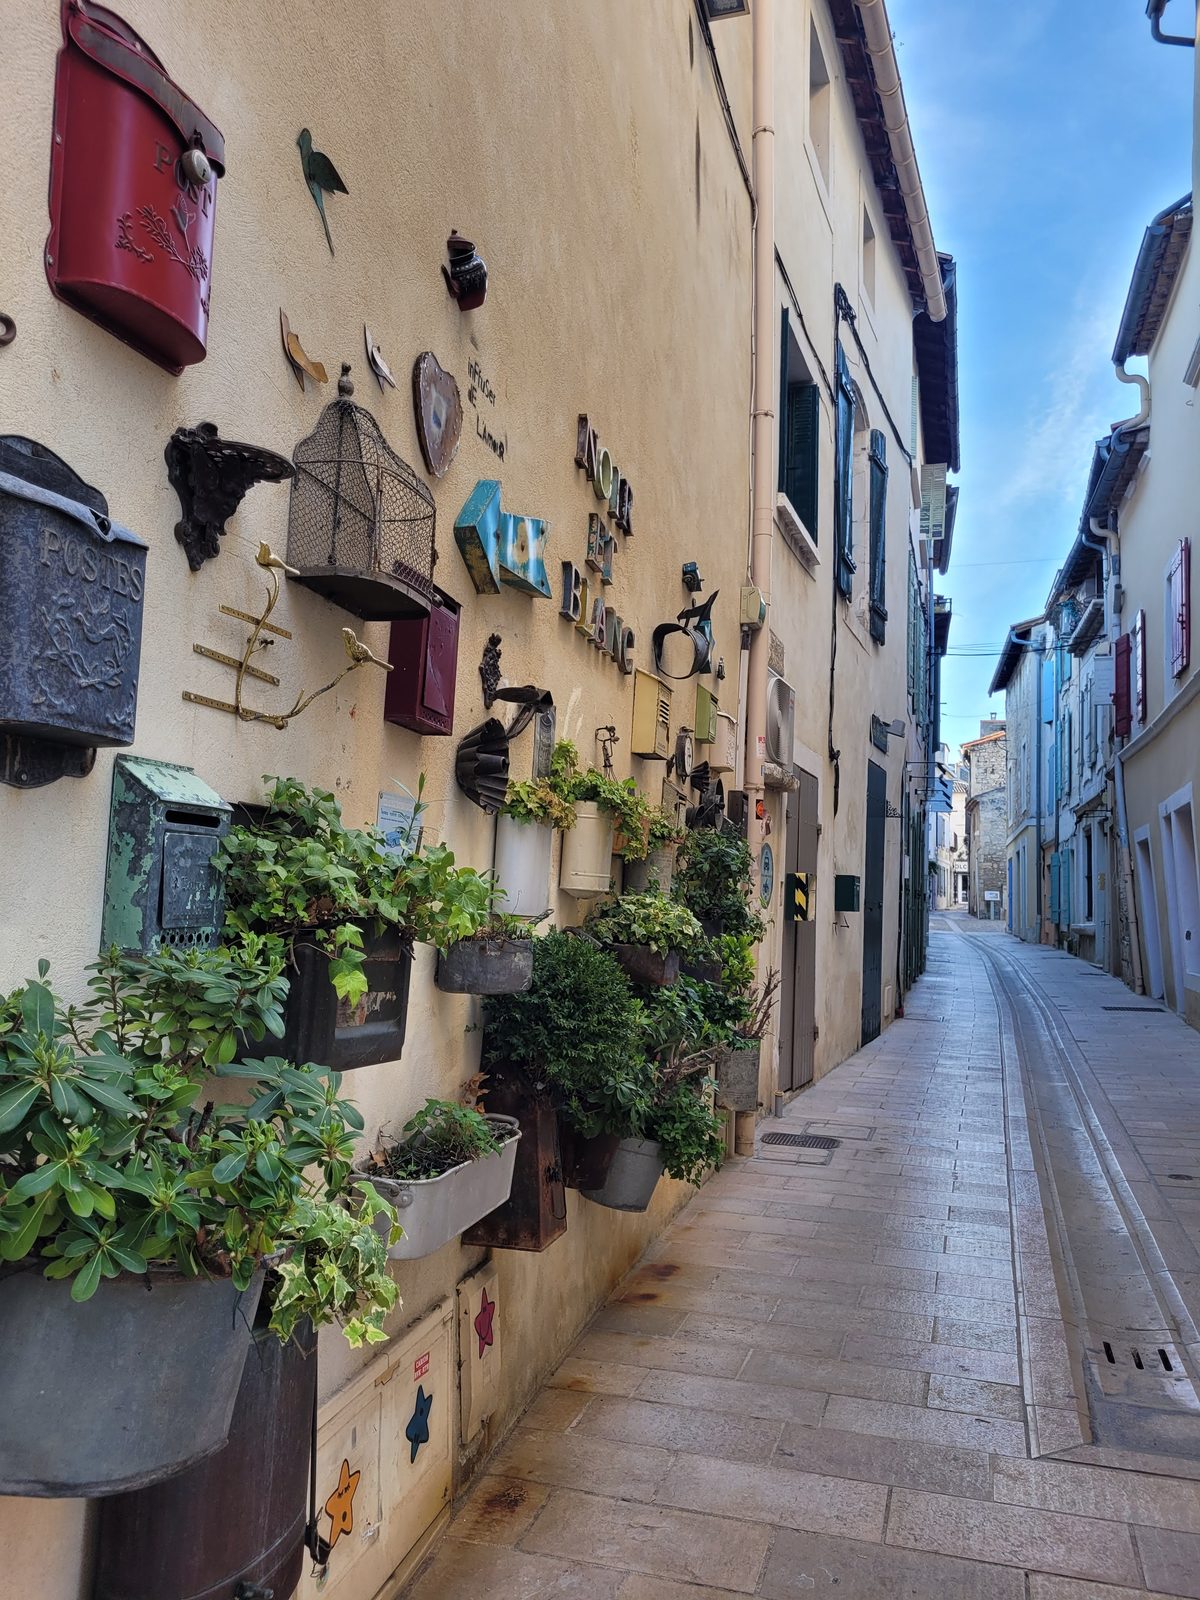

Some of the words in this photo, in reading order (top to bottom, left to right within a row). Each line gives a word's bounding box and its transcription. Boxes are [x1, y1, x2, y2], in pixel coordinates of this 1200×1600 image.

[574, 413, 634, 537] NOIR
[40, 527, 143, 603] POSTES
[585, 512, 618, 586] ET
[559, 560, 635, 675] BLANC
